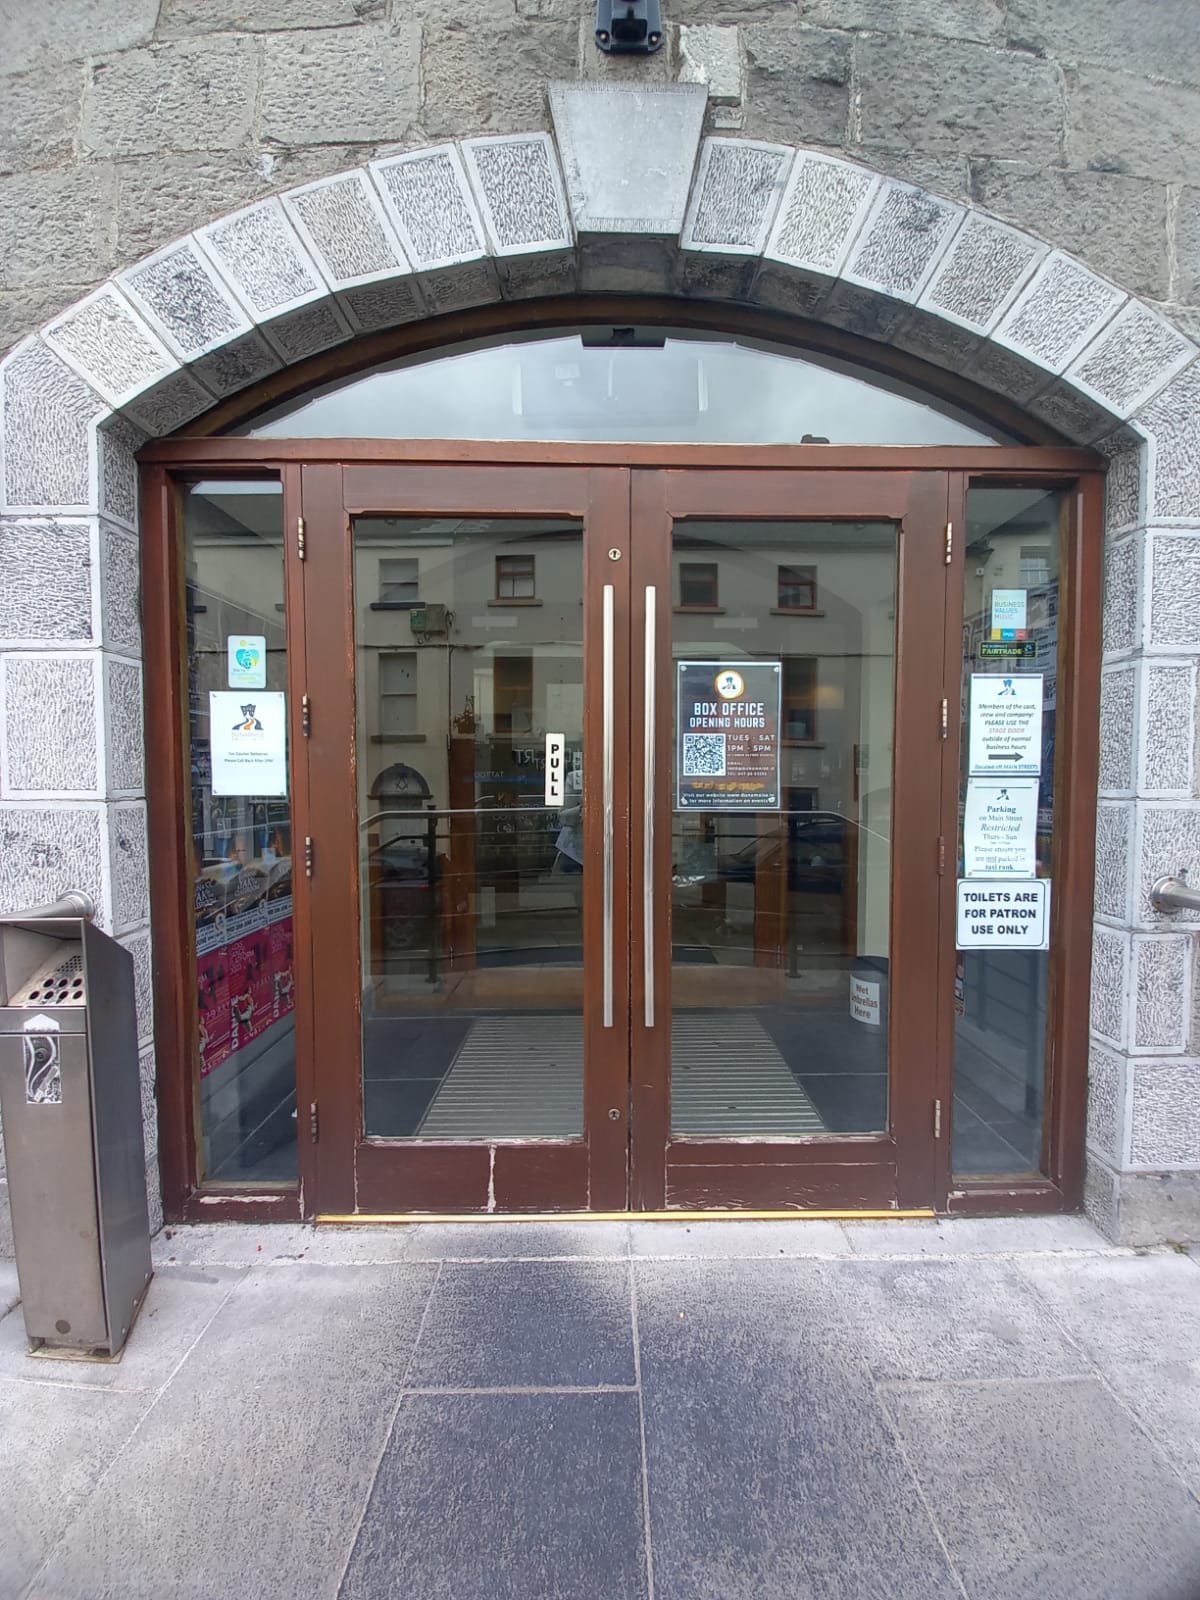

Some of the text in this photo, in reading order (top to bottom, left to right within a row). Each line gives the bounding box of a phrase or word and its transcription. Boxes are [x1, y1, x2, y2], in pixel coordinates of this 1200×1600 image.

[694, 702, 764, 716] BOX OFFICE
[690, 718, 765, 728] OPENING HOURS
[551, 744, 560, 796] PULL
[987, 806, 1016, 814] Parking
[980, 824, 1021, 832] Restricted
[964, 893, 1038, 902] TOILETS ARE
[964, 909, 1036, 918] FOR PATRON
[971, 925, 1029, 934] USE ONLY
[856, 983, 868, 995] Wet
[855, 1005, 871, 1019] Here
